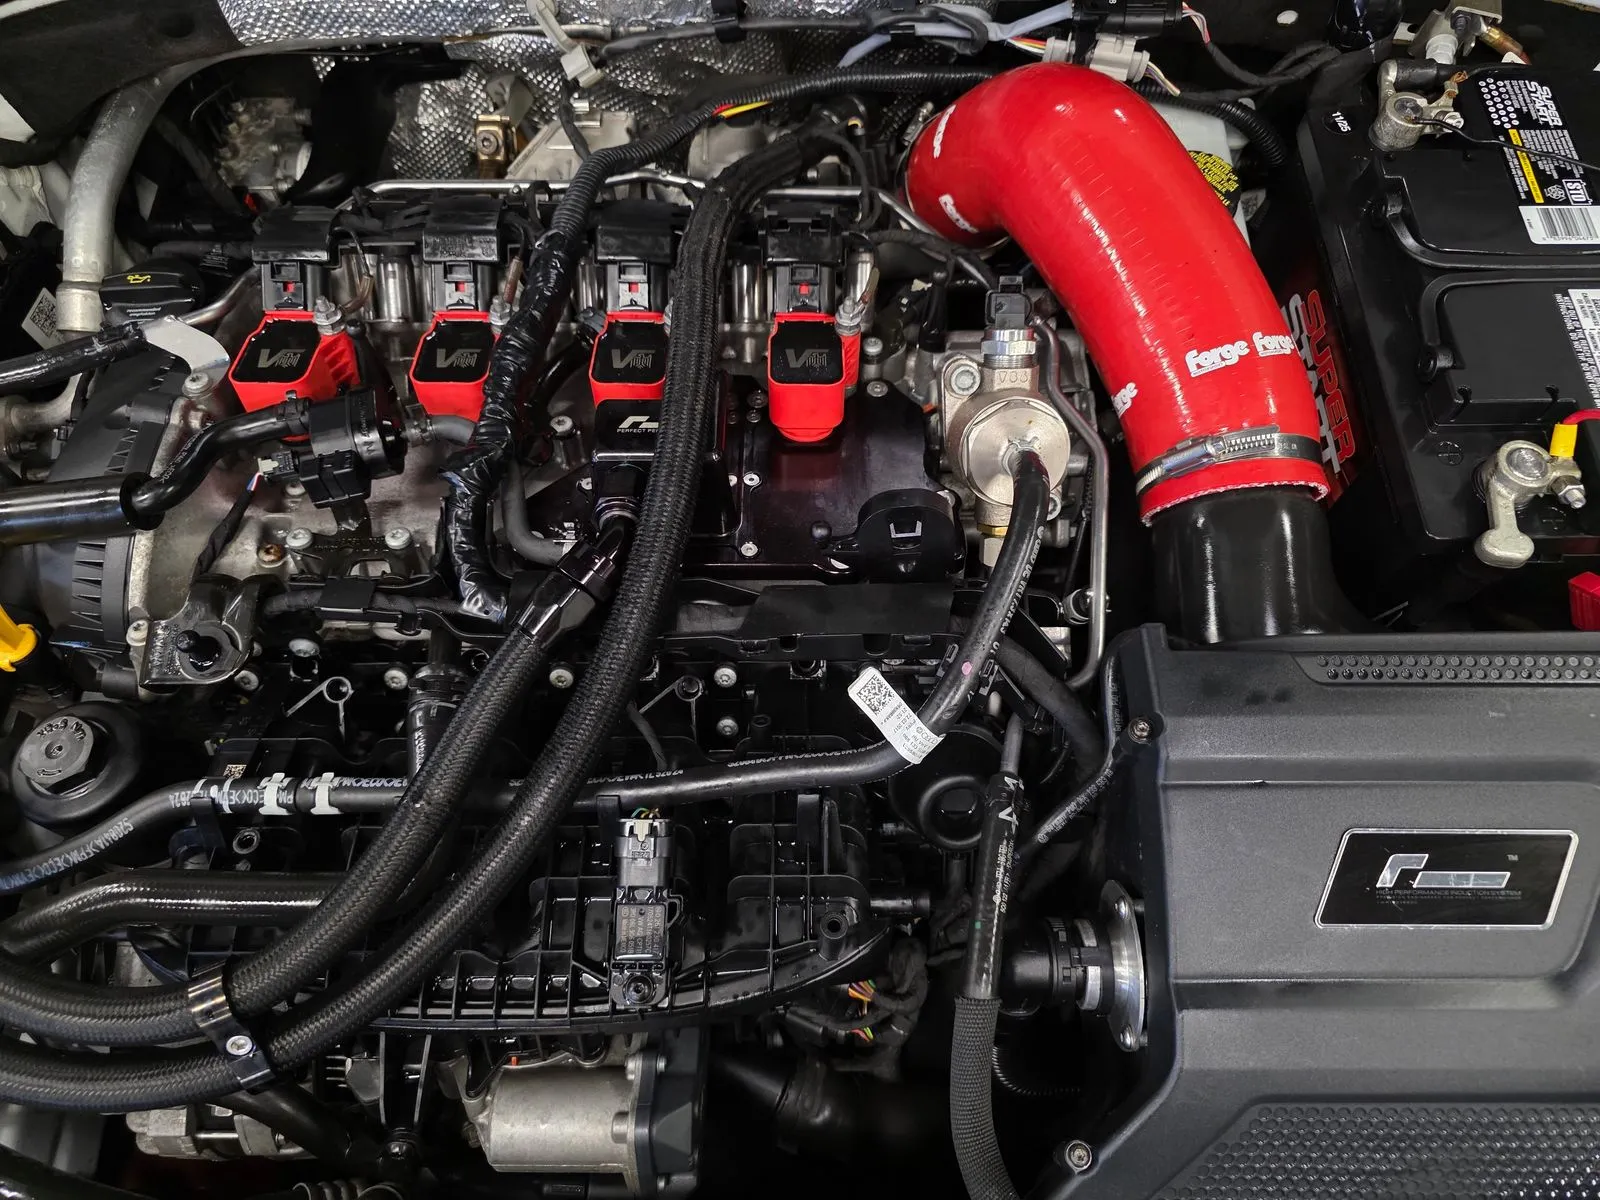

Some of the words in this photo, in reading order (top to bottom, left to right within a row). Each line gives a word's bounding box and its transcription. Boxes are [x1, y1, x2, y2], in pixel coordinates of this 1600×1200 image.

[1525, 80, 1549, 125] START
[1540, 86, 1562, 126] SUPER
[1332, 111, 1351, 132] 11/25
[1566, 182, 1587, 202] STD
[1562, 296, 1573, 309] KEEP
[1567, 310, 1578, 320] OUT
[1573, 320, 1581, 328] OF
[1569, 332, 1578, 340] DO
[1576, 328, 1585, 339] THE
[1185, 340, 1250, 373] Forge
[1252, 332, 1294, 354] Forge
[1573, 340, 1582, 352] NOT
[1580, 340, 1591, 356] REACH
[1581, 362, 1590, 371] DO
[1587, 357, 1596, 366] OF
[1300, 290, 1356, 465] SUPER
[1584, 372, 1594, 382] NOT
[1588, 383, 1600, 398] OPEN
[1111, 382, 1138, 419] orge
